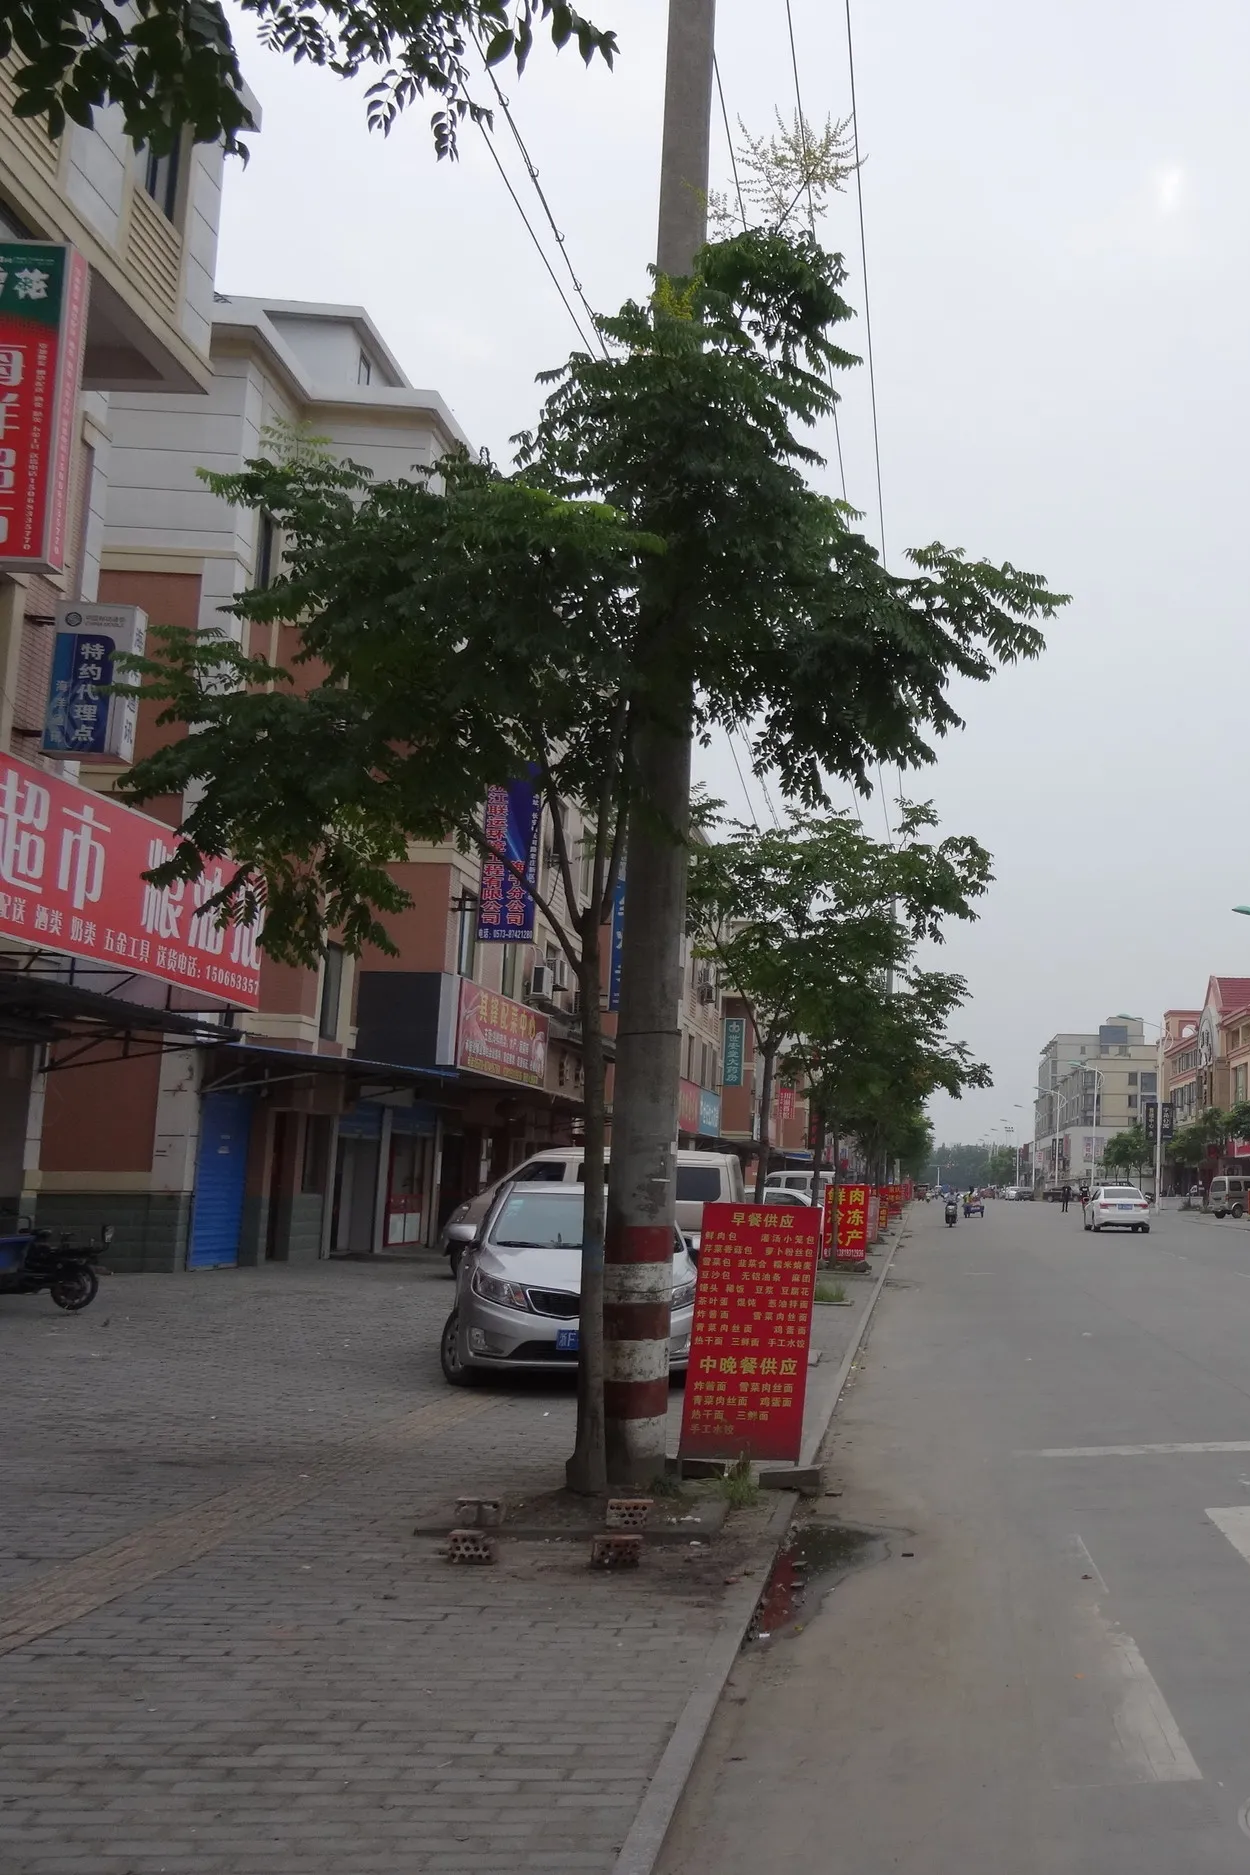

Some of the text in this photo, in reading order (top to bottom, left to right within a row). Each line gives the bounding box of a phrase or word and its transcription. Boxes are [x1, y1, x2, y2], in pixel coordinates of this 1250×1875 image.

[73, 643, 105, 742] 特约代理点
[0, 768, 111, 910] 超市
[34, 904, 63, 936] 酒类
[70, 916, 97, 948] 奶类
[103, 928, 151, 964] 五金工具
[828, 1188, 864, 1205] 鲜肉
[731, 1212, 795, 1228] 早餐供应
[827, 1209, 864, 1226] 冷冻
[825, 1229, 863, 1246] 水产
[701, 1271, 730, 1279] 豆沙包
[755, 1286, 774, 1294] 豆浆
[698, 1297, 728, 1306] 茶叶蛋
[773, 1326, 806, 1335] 鸡蛋面
[694, 1337, 723, 1345] 热干面
[767, 1339, 805, 1348] 手工水饺
[699, 1356, 798, 1376] 中晚餐供应
[692, 1395, 792, 1407] 青菜肉丝面 鸡蛋面
